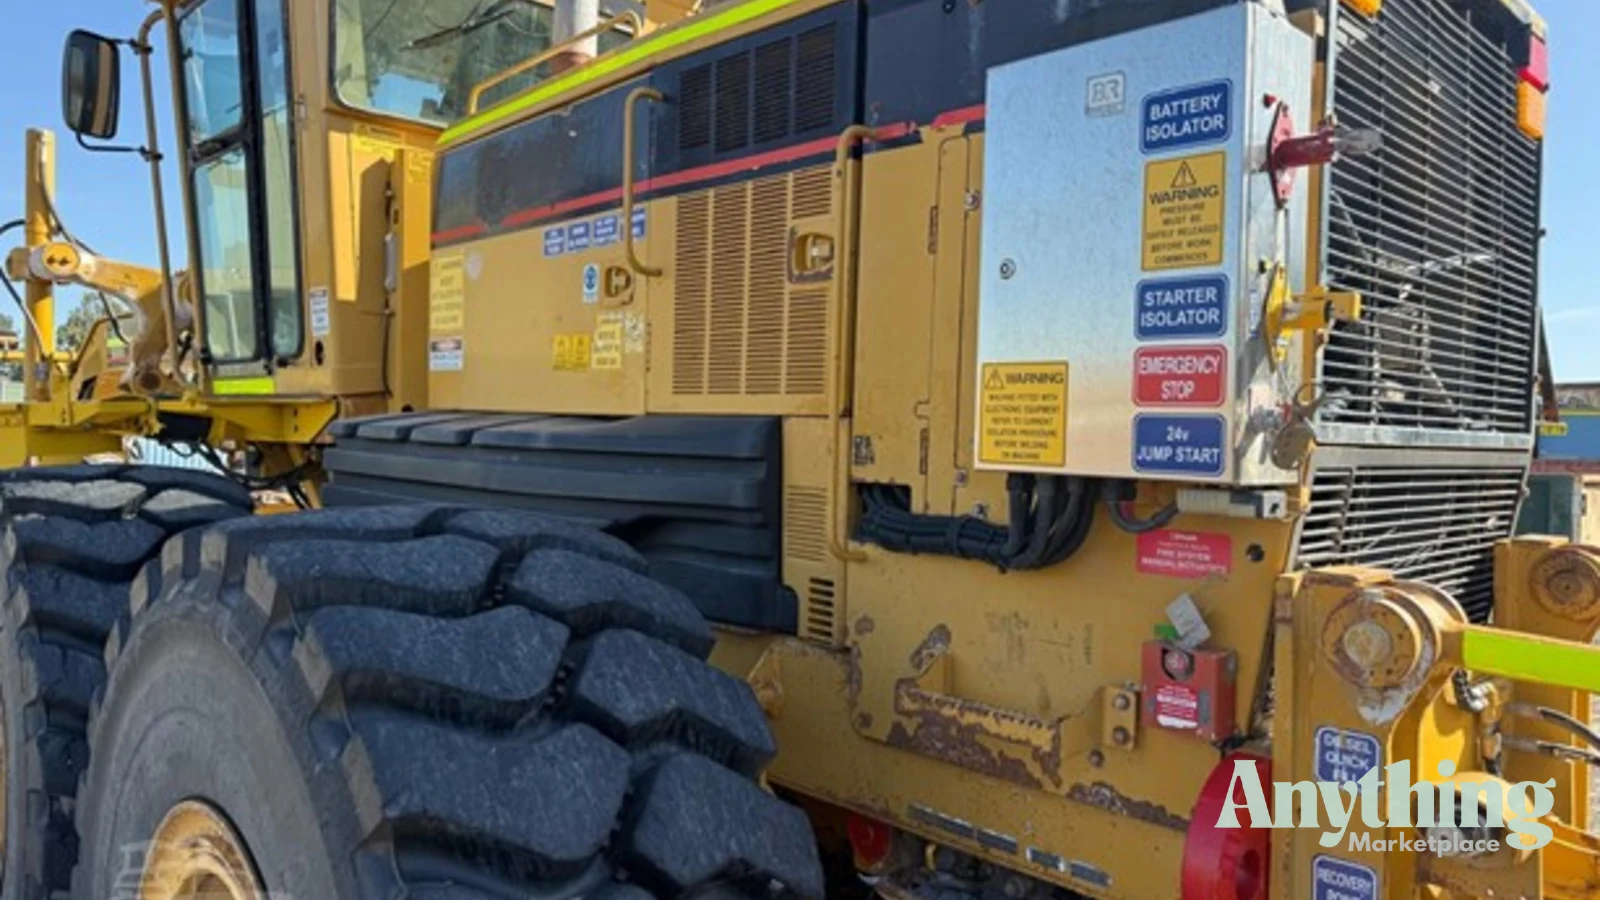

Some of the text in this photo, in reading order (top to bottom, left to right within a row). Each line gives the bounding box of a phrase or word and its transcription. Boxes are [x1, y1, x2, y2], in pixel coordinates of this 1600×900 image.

[1150, 93, 1222, 121] BATTERY
[1146, 114, 1225, 142] ISOLATOR
[1149, 185, 1219, 205] WARNING
[1144, 287, 1218, 306] STARTER
[1140, 308, 1220, 327] ISOLATOR
[1139, 355, 1220, 375] EMERGENCY
[1005, 372, 1064, 385] WARNING
[1161, 381, 1196, 400] STOP
[1166, 426, 1189, 442] 24v
[1137, 446, 1220, 463] JUMP START
[1318, 868, 1371, 895] RECOVERY
[1326, 888, 1363, 900] POIN
